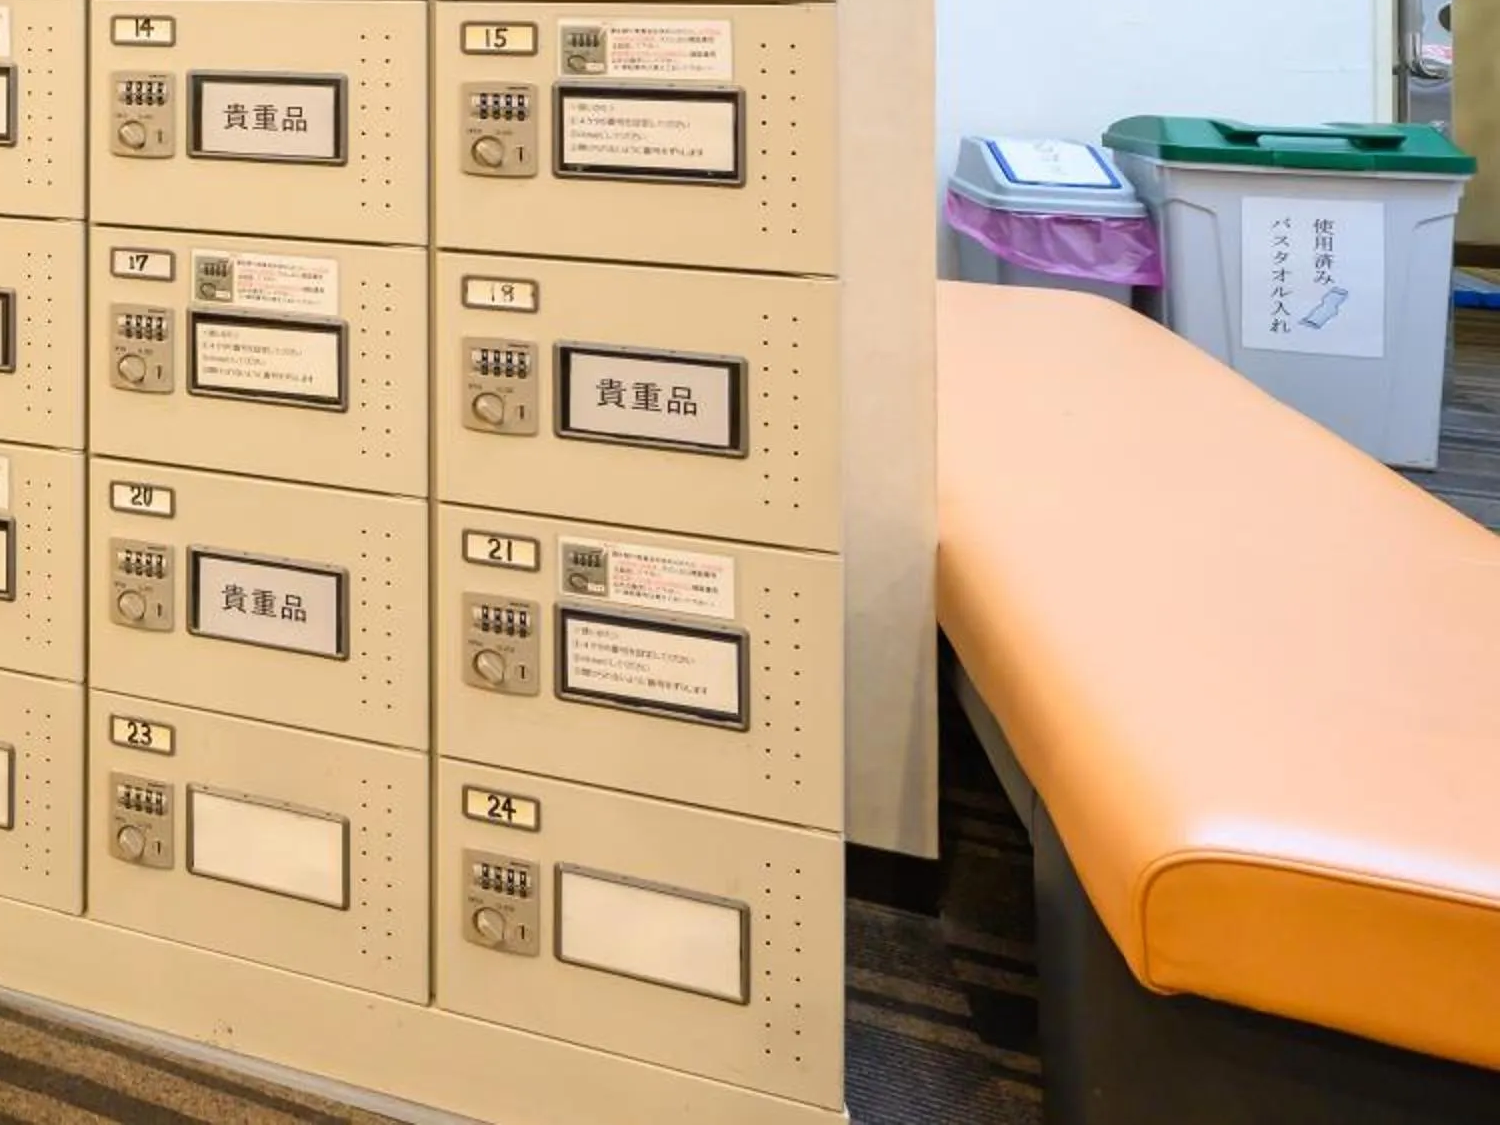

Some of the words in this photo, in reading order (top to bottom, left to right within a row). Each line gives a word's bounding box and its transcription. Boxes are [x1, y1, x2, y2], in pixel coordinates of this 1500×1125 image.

[135, 19, 154, 38] 14
[485, 28, 508, 47] 15
[222, 103, 307, 132] 貴重品
[129, 254, 149, 272] 17
[1313, 218, 1335, 286] 使用済み
[1270, 216, 1293, 334] バスタオル入れ
[595, 378, 697, 417] 貴重品
[130, 485, 152, 506] 20
[487, 538, 513, 562] 21
[221, 584, 308, 623] 貴重品
[127, 721, 152, 746] 23
[487, 794, 517, 821] 24
